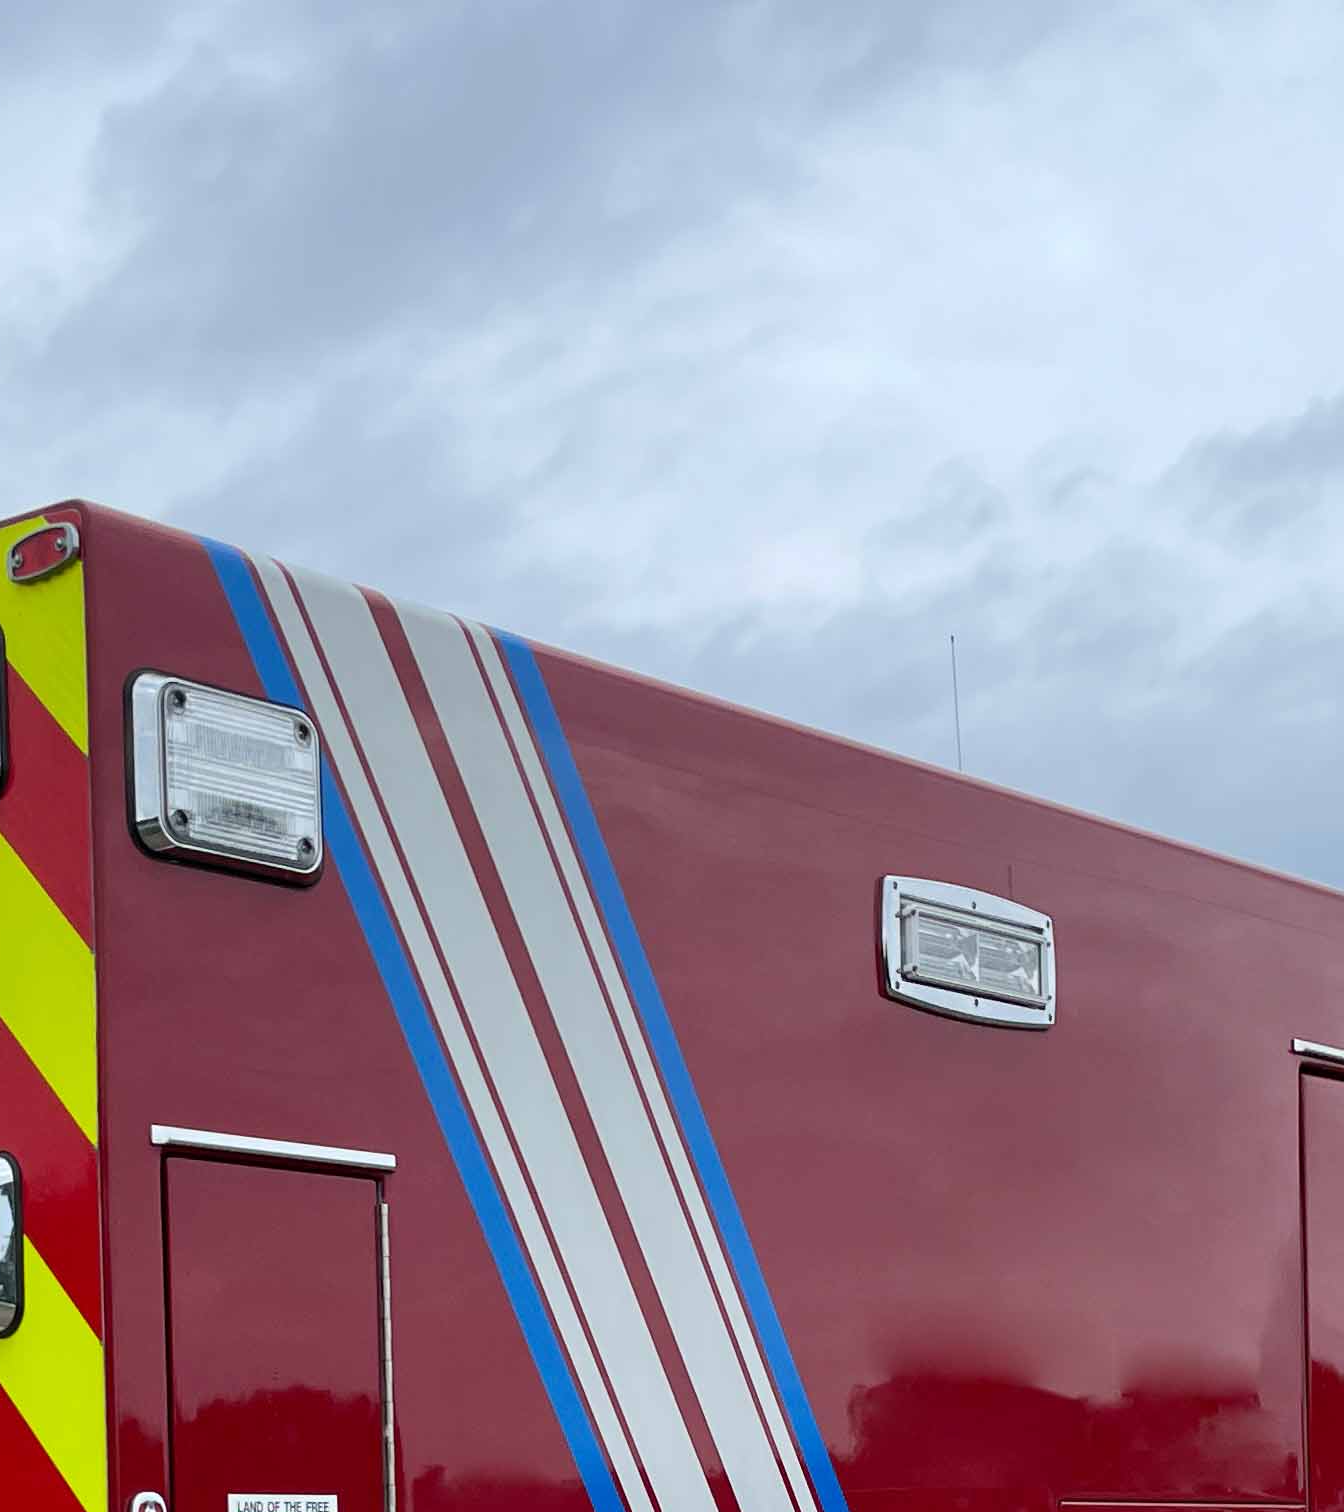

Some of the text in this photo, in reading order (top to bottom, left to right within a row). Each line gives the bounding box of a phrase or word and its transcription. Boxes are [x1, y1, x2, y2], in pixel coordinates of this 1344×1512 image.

[267, 1501, 280, 1512] OF
[284, 1501, 302, 1512] THE
[306, 1501, 329, 1512] FREE
